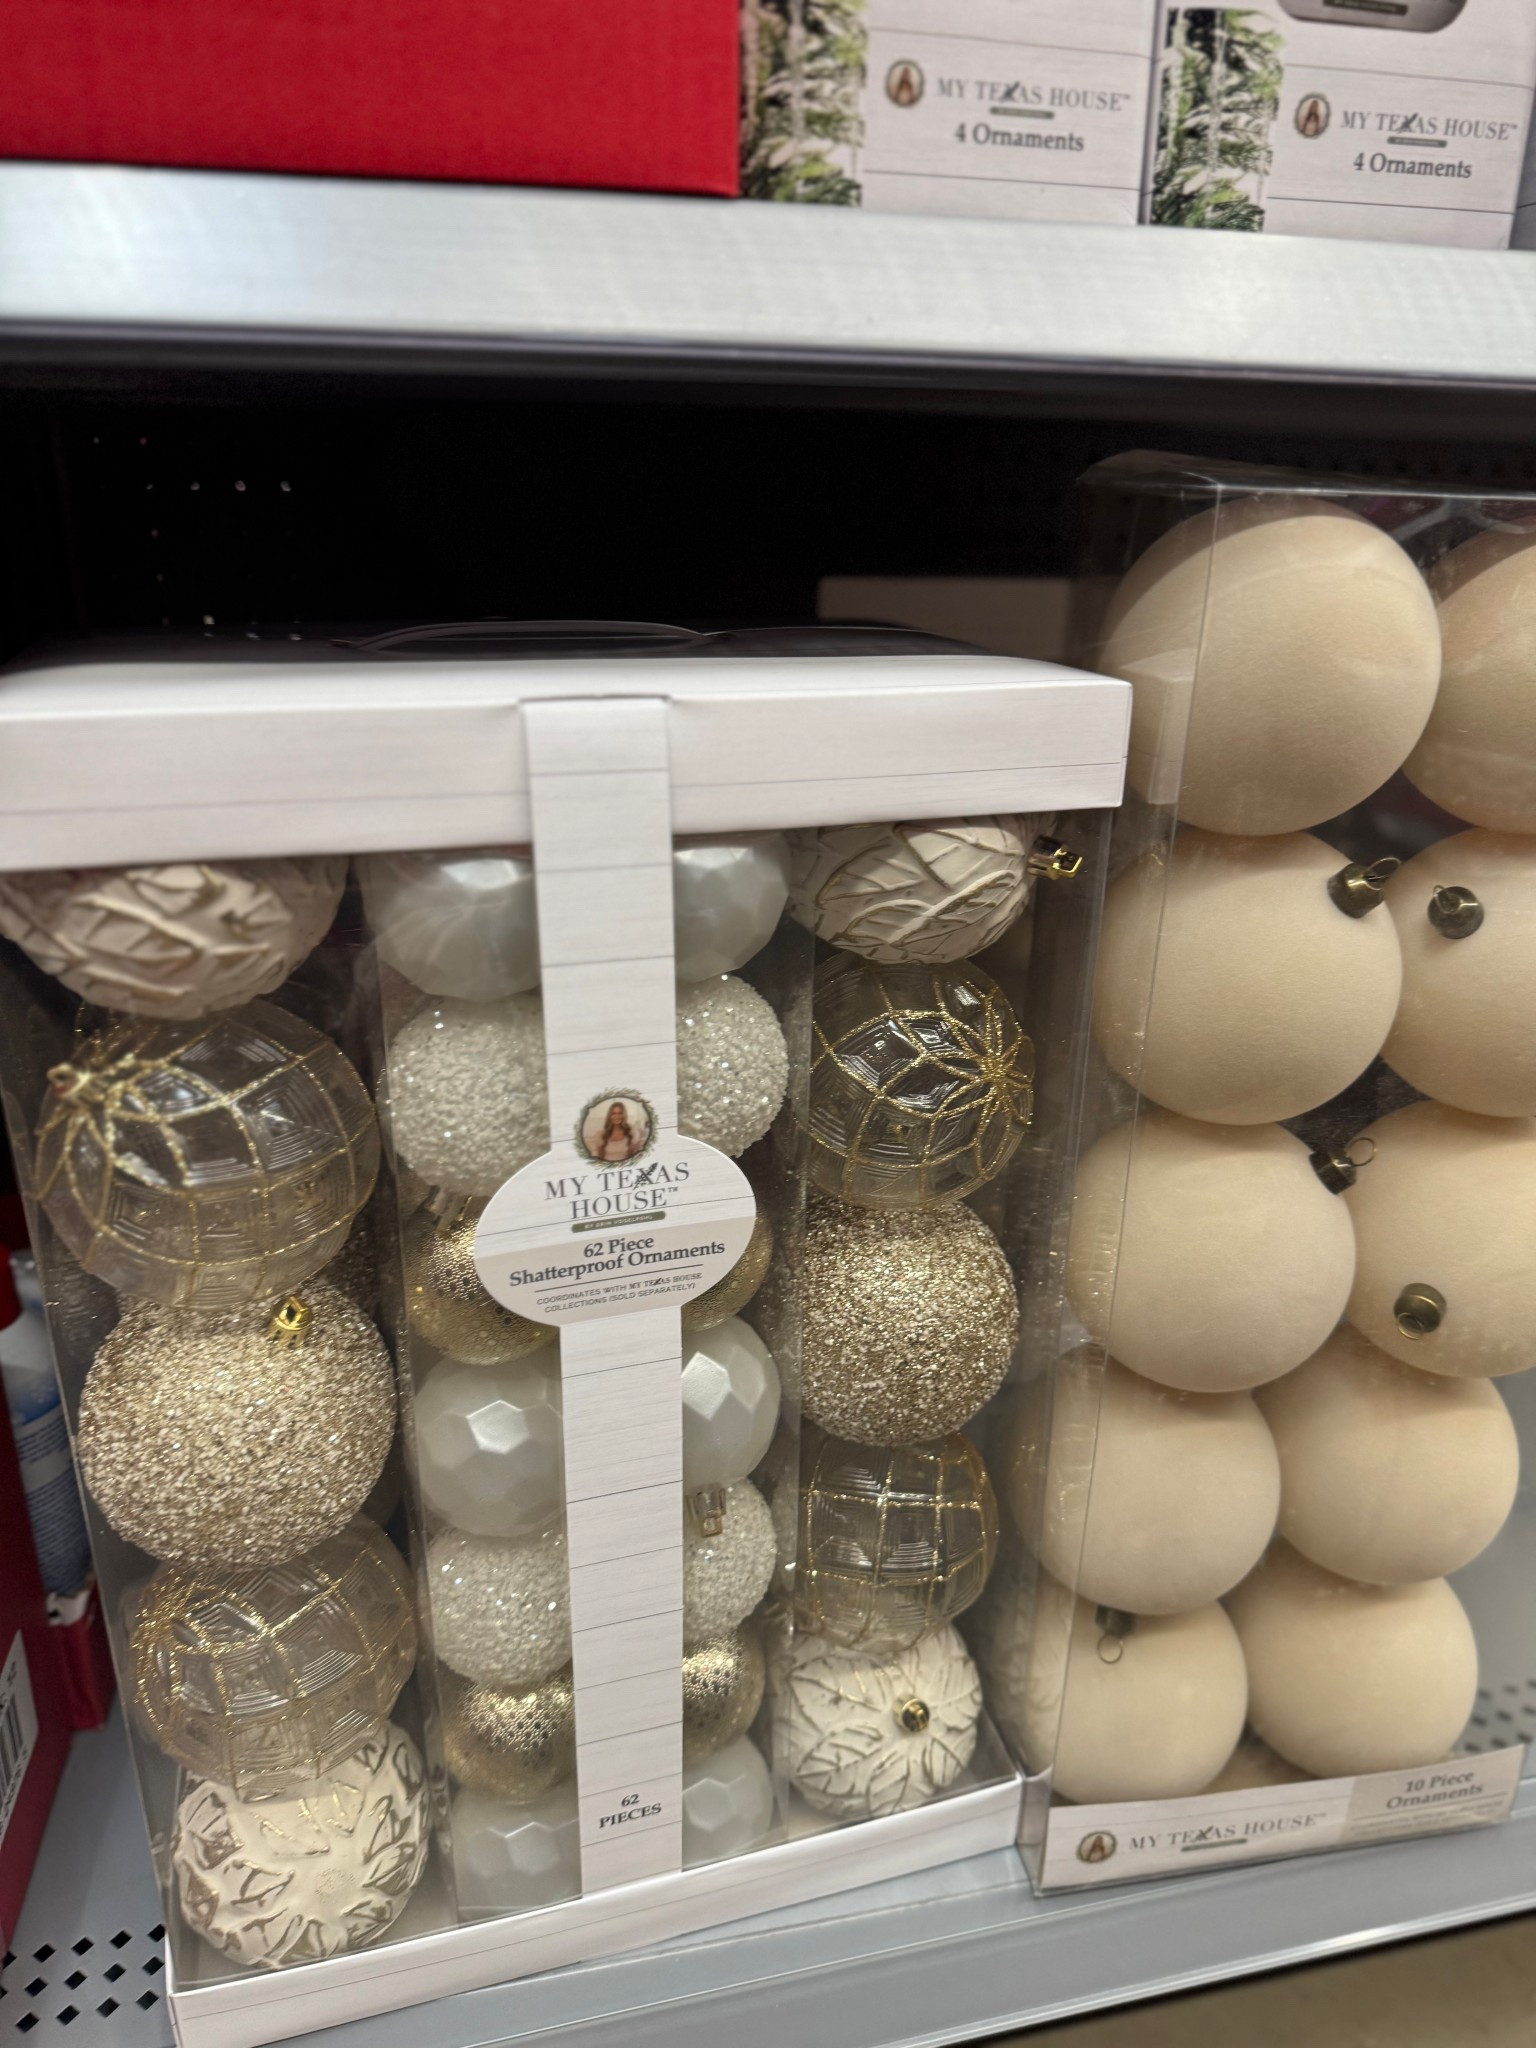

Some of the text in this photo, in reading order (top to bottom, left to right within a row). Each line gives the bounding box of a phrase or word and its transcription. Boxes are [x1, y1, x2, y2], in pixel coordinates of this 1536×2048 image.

[937, 77, 968, 98] MY
[974, 81, 1042, 105] TEXAS
[1341, 110, 1371, 129] MY
[1376, 112, 1438, 134] TEXAS
[955, 123, 1084, 151] 4 Ornaments
[1353, 152, 1472, 178] 4 Ornaments
[544, 1162, 690, 1200] MY TEXAS
[584, 1237, 654, 1258] 62 Piece
[509, 1241, 725, 1287] Shatterproof Ornaments
[536, 1289, 601, 1305] COORDINATES
[603, 1284, 627, 1294] WITH
[629, 1281, 641, 1290] MY
[643, 1276, 671, 1288] TEXAS
[544, 1282, 696, 1313] COLLECTIONS (SOLD SEPARATELY)
[1405, 1772, 1474, 1793] 10 Piece
[621, 1794, 640, 1807] 62
[1386, 1783, 1484, 1810] Ornaments
[599, 1803, 662, 1829] PIECES
[1129, 1834, 1160, 1850] MY
[1168, 1825, 1236, 1845] TEXAS
